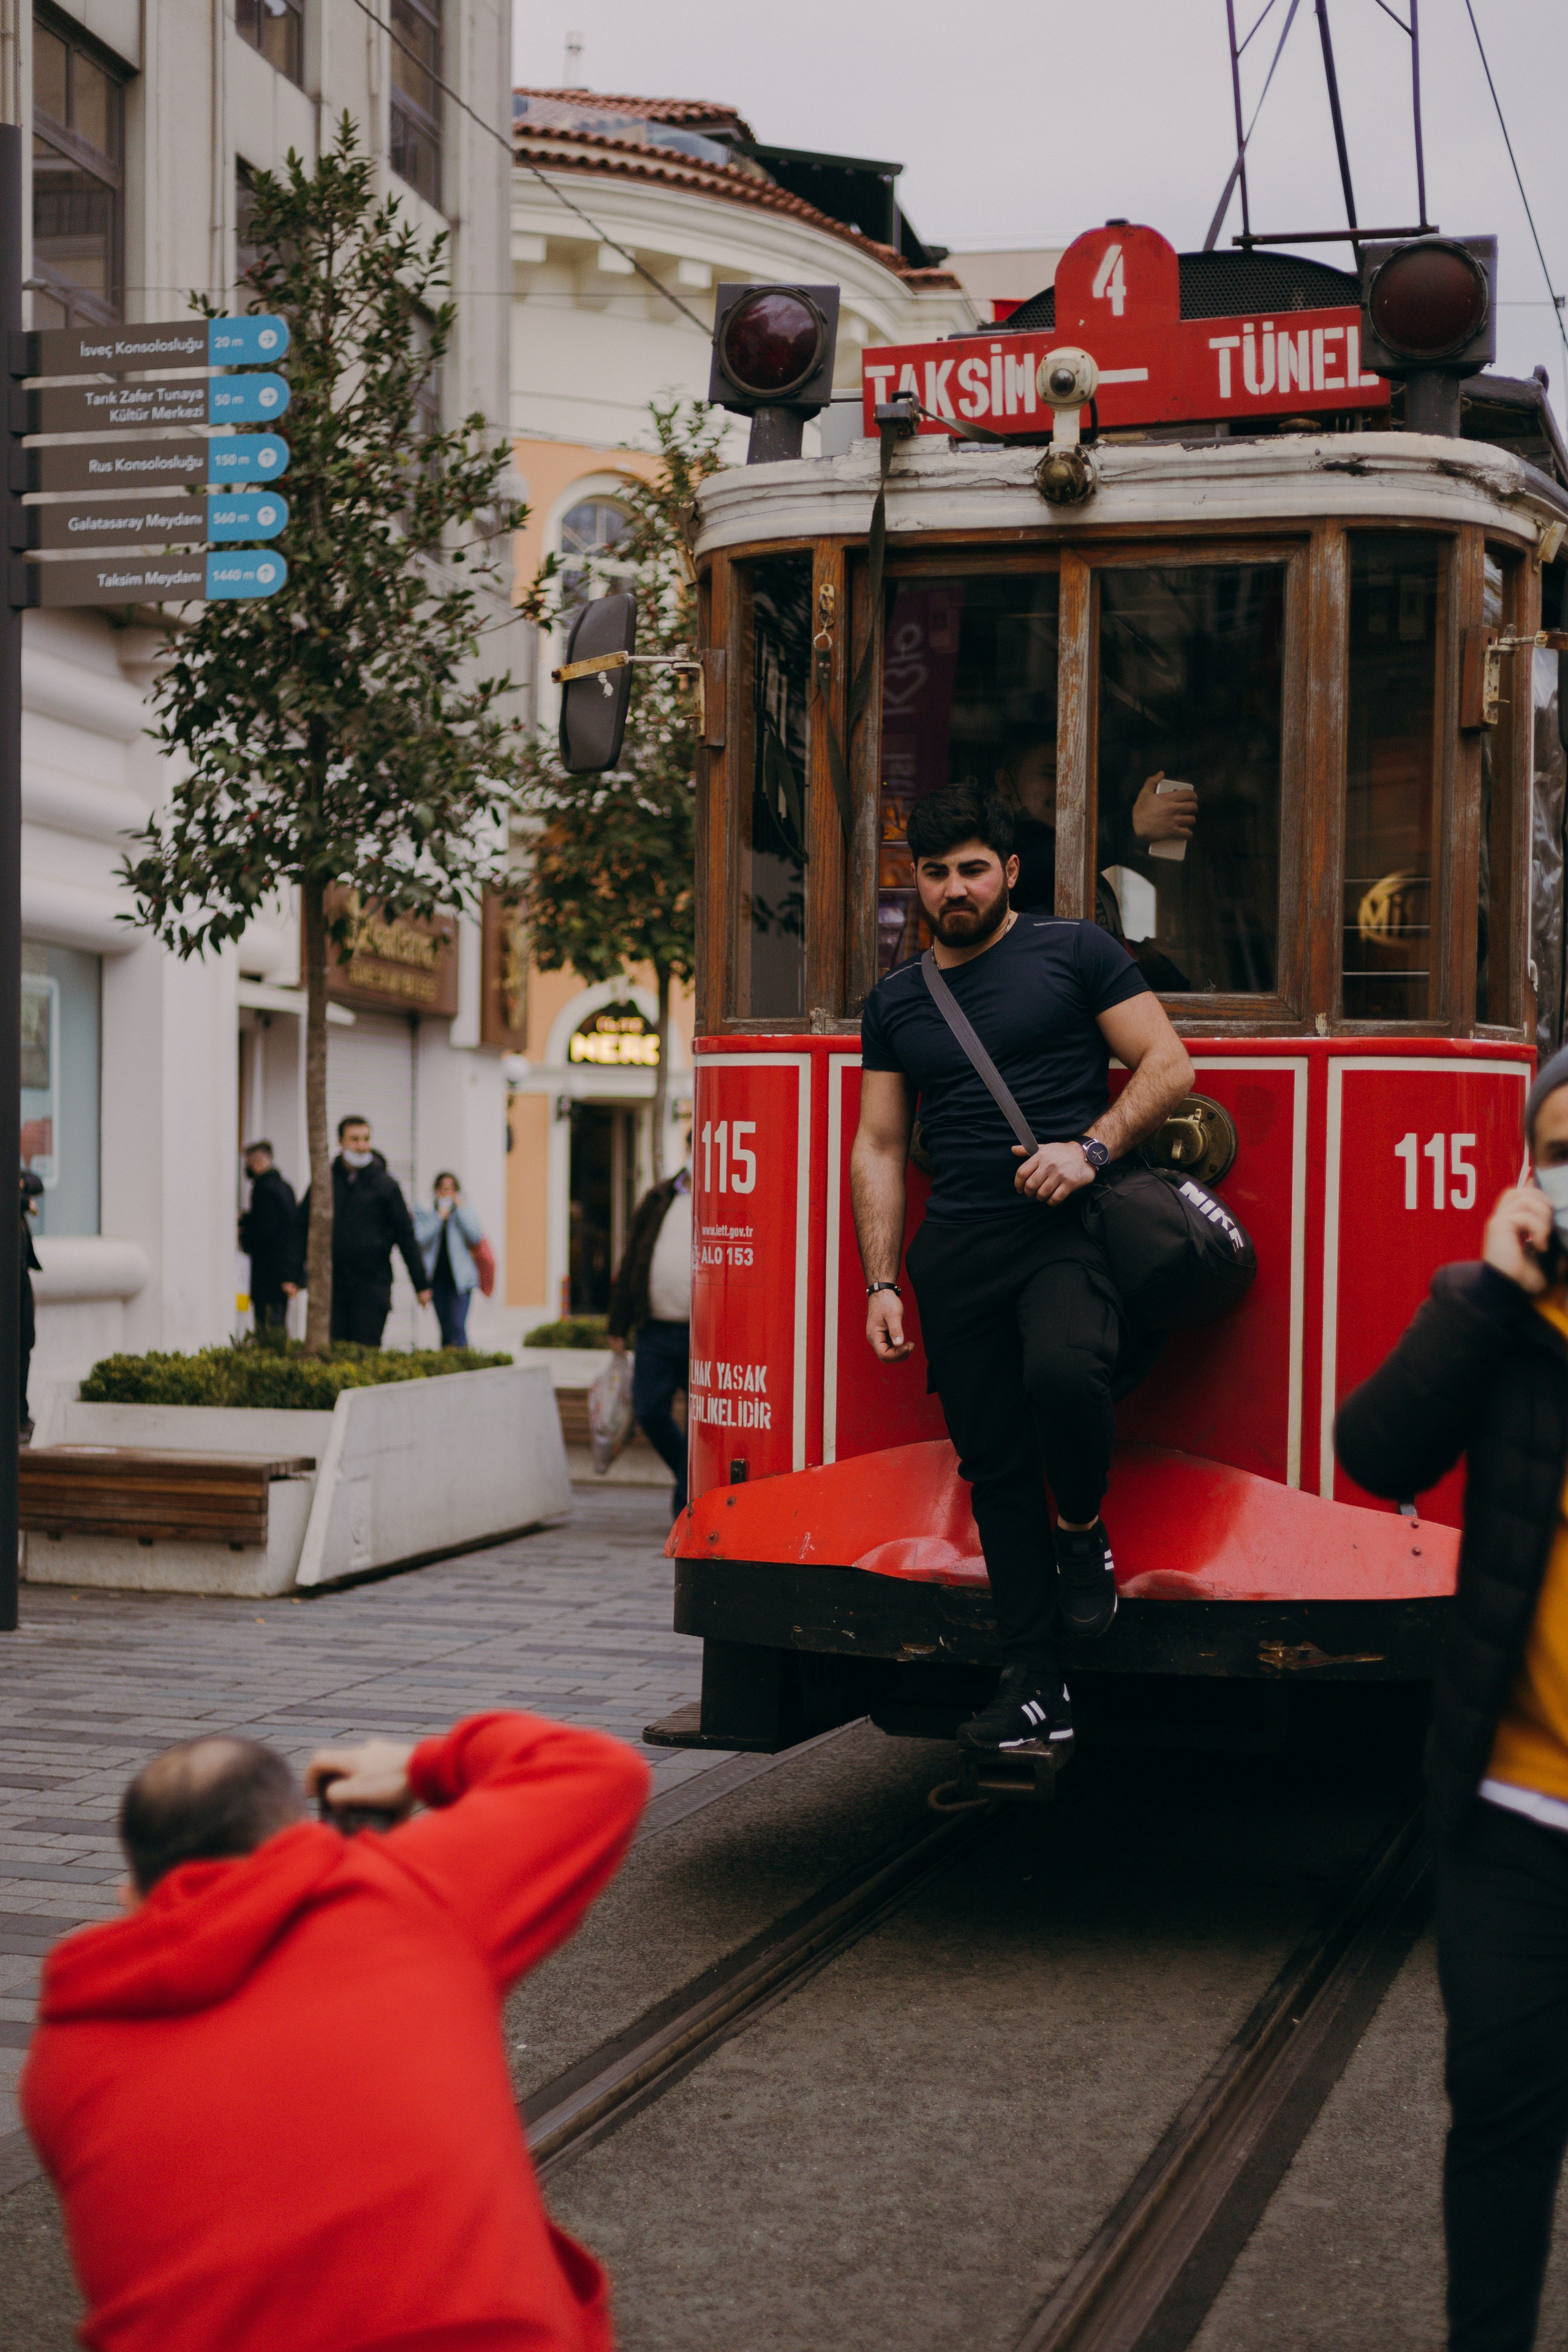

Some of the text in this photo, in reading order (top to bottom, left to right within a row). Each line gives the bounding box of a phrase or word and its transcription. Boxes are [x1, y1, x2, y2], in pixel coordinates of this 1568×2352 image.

[1092, 245, 1126, 315] 4
[80, 337, 204, 359] İsveç Konsolosluğu
[214, 336, 244, 348] 20 m
[864, 322, 1379, 423] TAKSİM TÜNEL
[85, 388, 205, 405] Tarık Zafer Tunaya
[214, 394, 244, 405] 50 m
[110, 404, 204, 423] Kültür Merkezi
[89, 454, 204, 473] Rus Konsolosluğu
[238, 456, 251, 465] m
[67, 511, 203, 532] Galatasaray Meydanı
[238, 514, 250, 523] m
[97, 570, 202, 588] Taksim Meydanı
[243, 571, 255, 580] m
[701, 1120, 756, 1194] 115
[1395, 1133, 1476, 1210] 115
[701, 1224, 753, 1238] www.iett.gov.tr
[701, 1246, 753, 1266] ALO 153
[716, 1362, 767, 1393] YASAK
